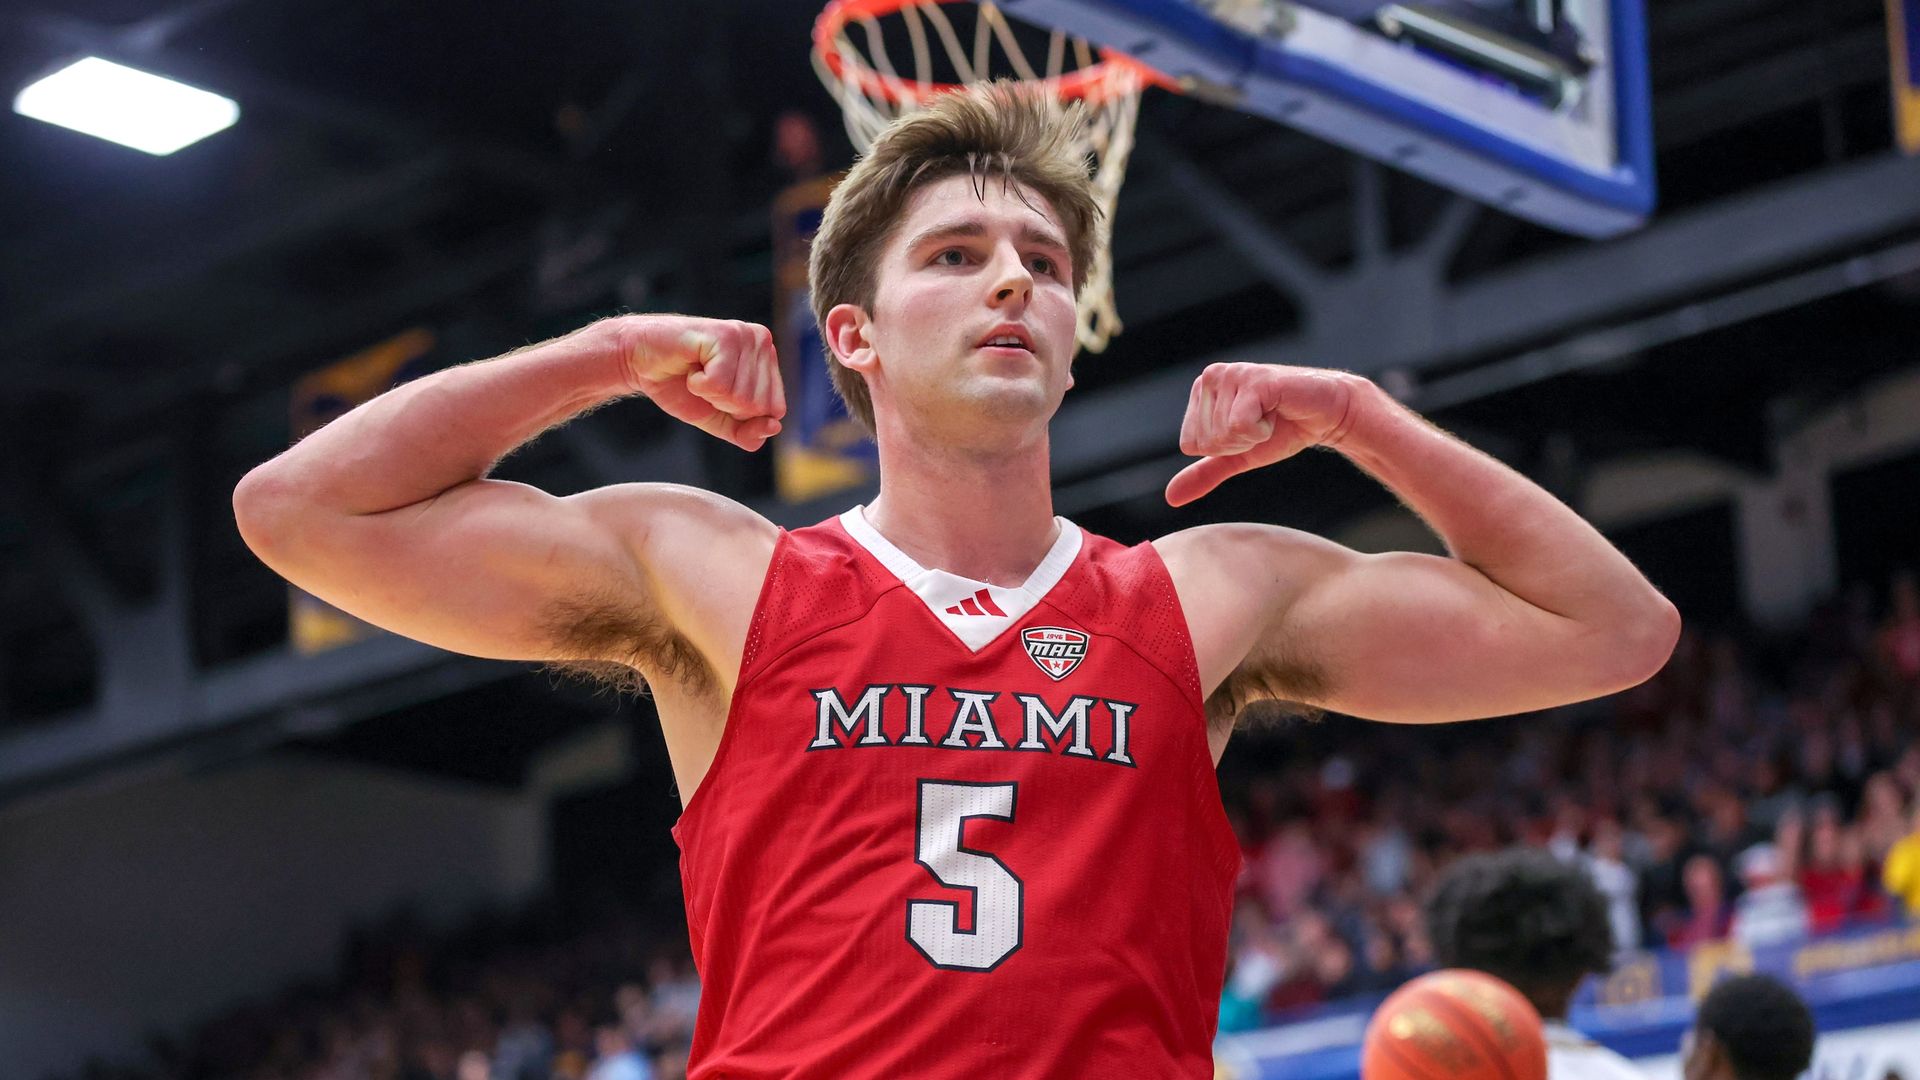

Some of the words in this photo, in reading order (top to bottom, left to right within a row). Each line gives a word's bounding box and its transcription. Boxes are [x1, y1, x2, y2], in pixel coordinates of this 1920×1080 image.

[1028, 642, 1085, 658] MAC
[805, 683, 1139, 768] MIAMI
[905, 778, 1024, 973] 5
